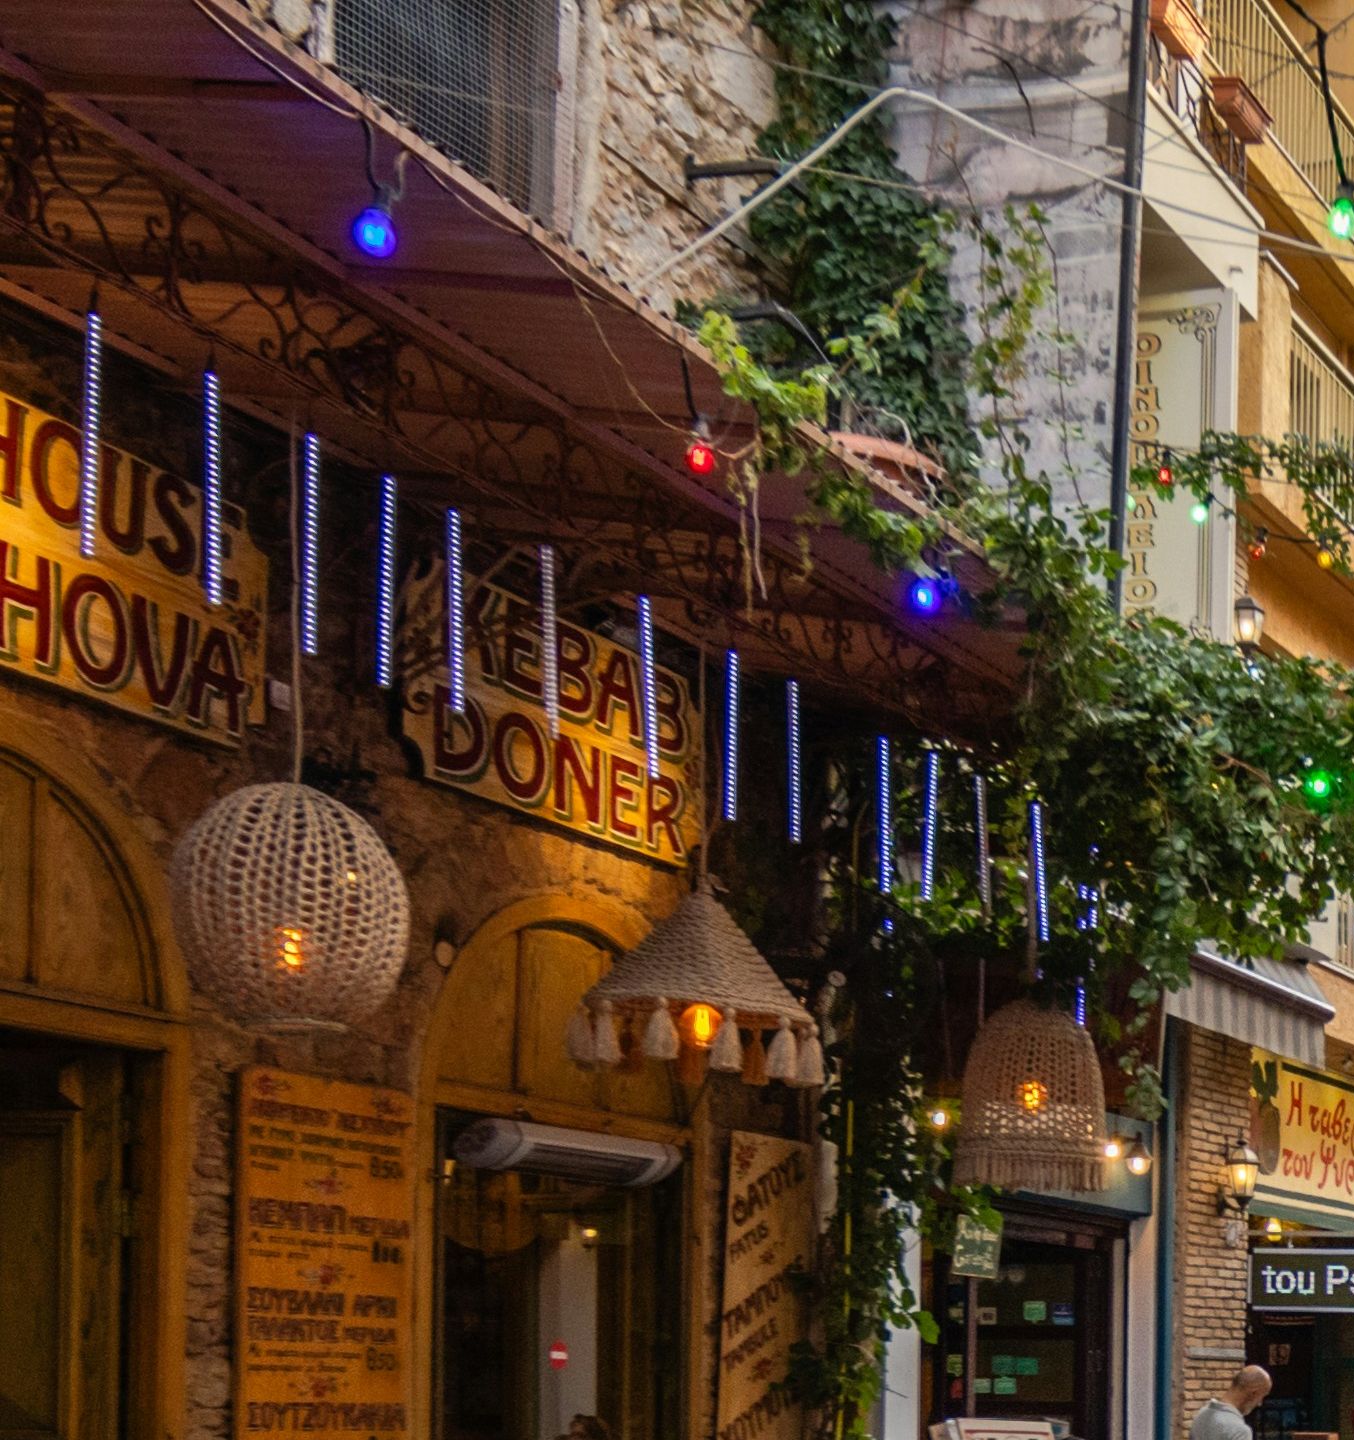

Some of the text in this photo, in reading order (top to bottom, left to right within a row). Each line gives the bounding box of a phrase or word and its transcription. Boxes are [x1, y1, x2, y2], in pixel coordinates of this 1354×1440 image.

[434, 684, 686, 864] DONER
[1282, 1148, 1315, 1180] του
[1261, 1265, 1315, 1295] tou
